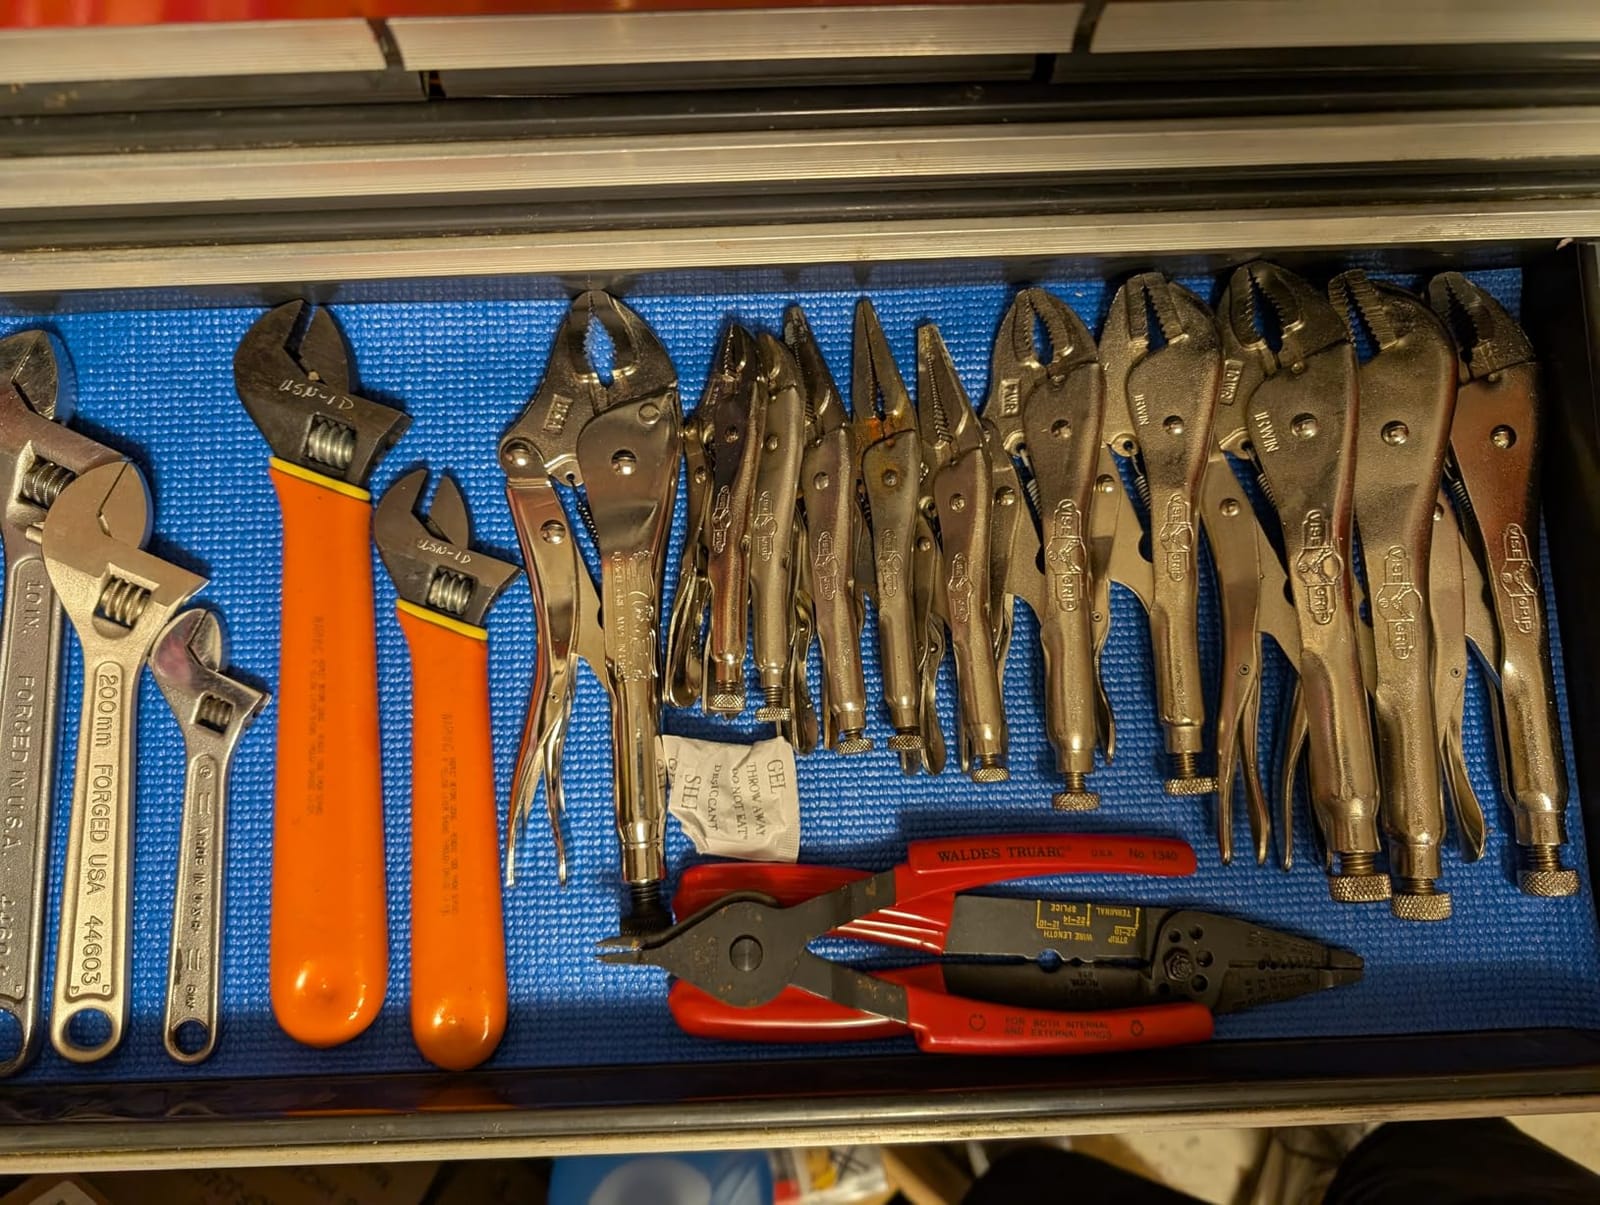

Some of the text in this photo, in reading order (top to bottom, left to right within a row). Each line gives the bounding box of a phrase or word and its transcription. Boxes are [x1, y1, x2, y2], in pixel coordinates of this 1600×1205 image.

[1134, 394, 1149, 426] IRWIN
[1254, 411, 1279, 454] IRWIN
[1060, 503, 1074, 611] VISE GRIP
[1172, 496, 1184, 580] VISE GRIP
[1308, 512, 1328, 622] VISE GRIP
[1509, 526, 1533, 631] VISE GRIP
[1391, 549, 1409, 658] VISE GRIP
[11, 675, 36, 763] FORGED
[8, 769, 32, 791] IN
[766, 759, 786, 794] GEL
[707, 764, 722, 831] DESICCANT
[746, 762, 766, 836] THROW AWAY
[81, 674, 119, 986] 200mm FORGED USA 44603
[194, 826, 210, 866] MADE
[938, 847, 1000, 862] WALDES
[192, 872, 207, 887] IN
[1050, 903, 1077, 913] SPLICE
[1063, 915, 1086, 924] 22-14
[1096, 907, 1131, 917] TERMINAL
[1043, 930, 1128, 944] STRIP WIRE LENGTH
[1033, 1018, 1061, 1028] BOTH
